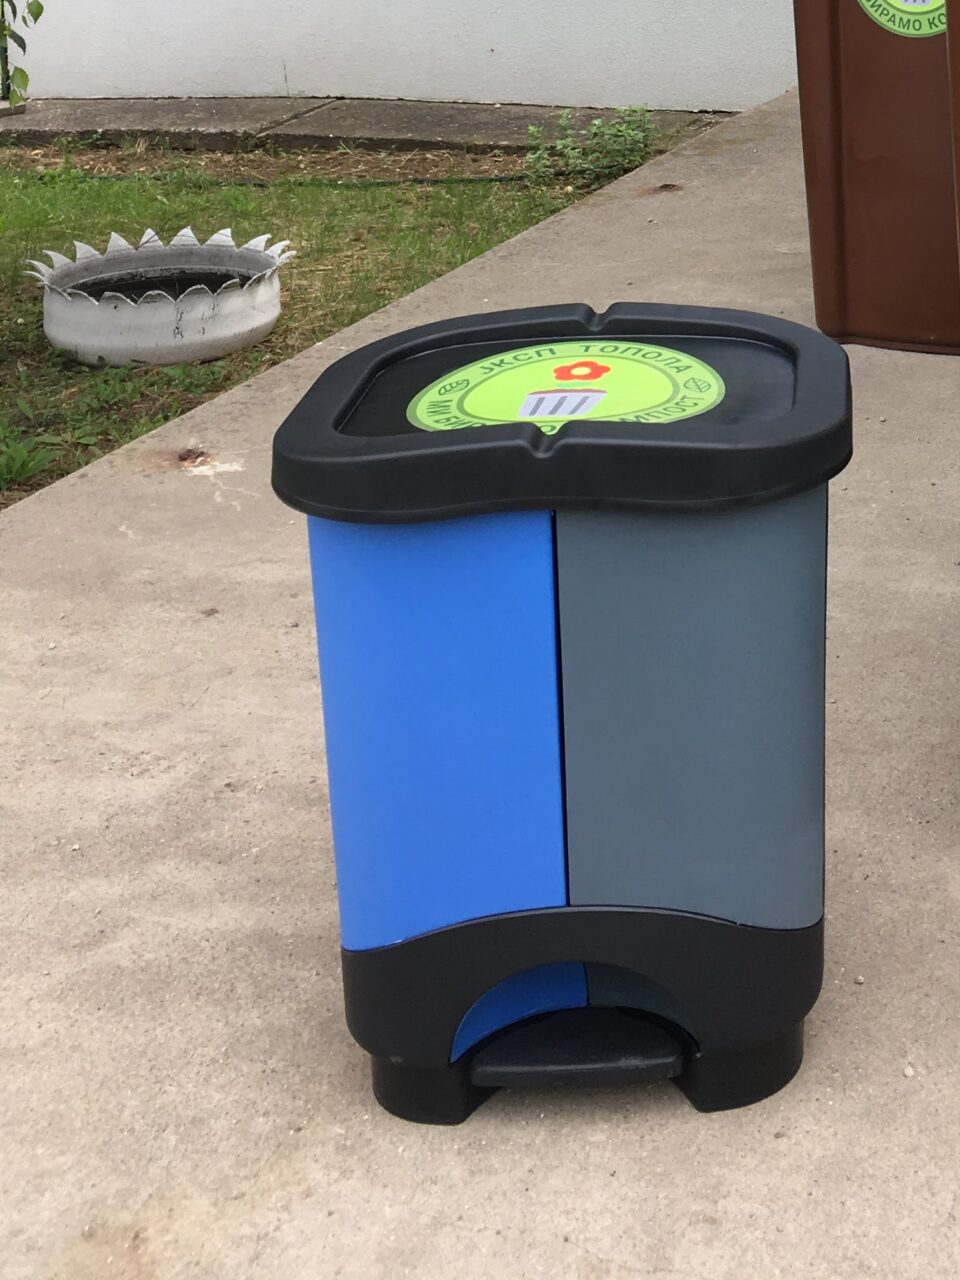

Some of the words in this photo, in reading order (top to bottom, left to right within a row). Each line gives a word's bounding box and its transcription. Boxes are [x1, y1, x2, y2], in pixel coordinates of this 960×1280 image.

[927, 12, 946, 30] КО
[479, 347, 557, 375] ЈКСП
[579, 344, 693, 374] ТОПОЛА
